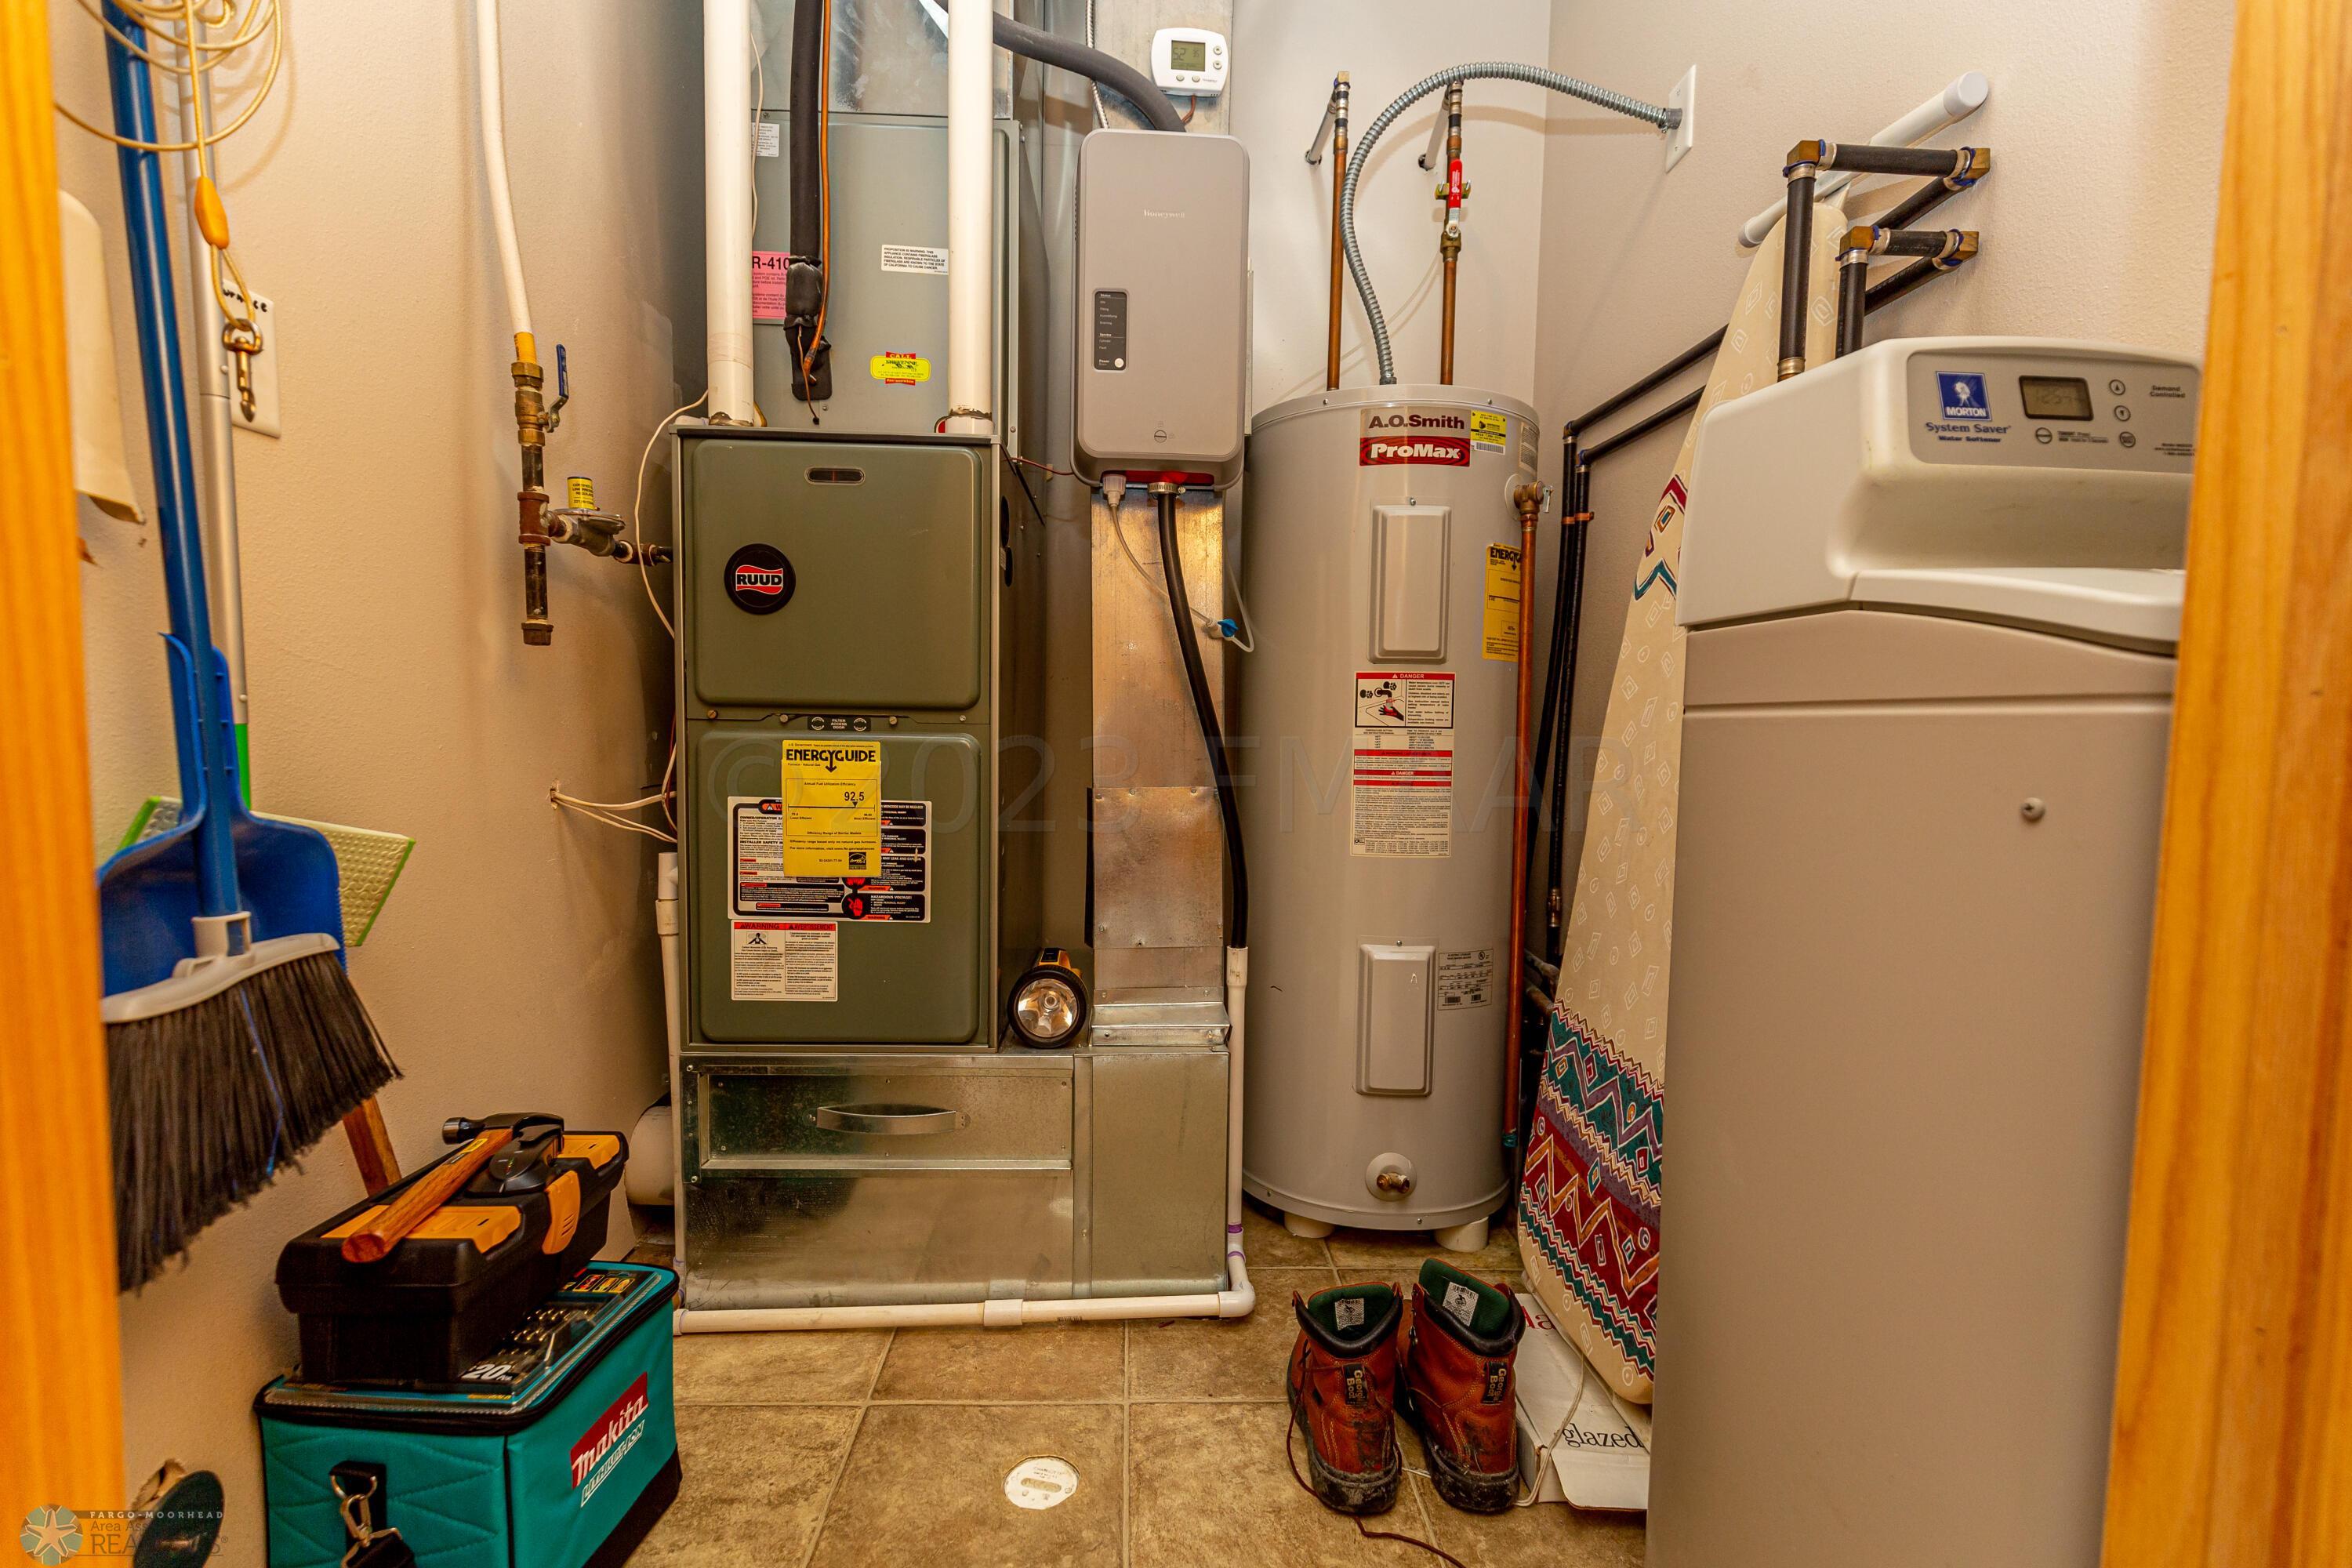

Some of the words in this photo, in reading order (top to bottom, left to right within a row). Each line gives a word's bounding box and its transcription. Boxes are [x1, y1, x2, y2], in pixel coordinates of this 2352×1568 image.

[1946, 407, 1987, 417] MORTON
[1926, 422, 1969, 433] System
[1974, 423, 2009, 434] Saver
[1370, 443, 1460, 459] ProMax
[737, 574, 782, 586] RUUD
[786, 750, 876, 762] ENERGYGUIDE
[844, 792, 864, 801] 92.5
[1562, 1422, 1644, 1449] glazed
